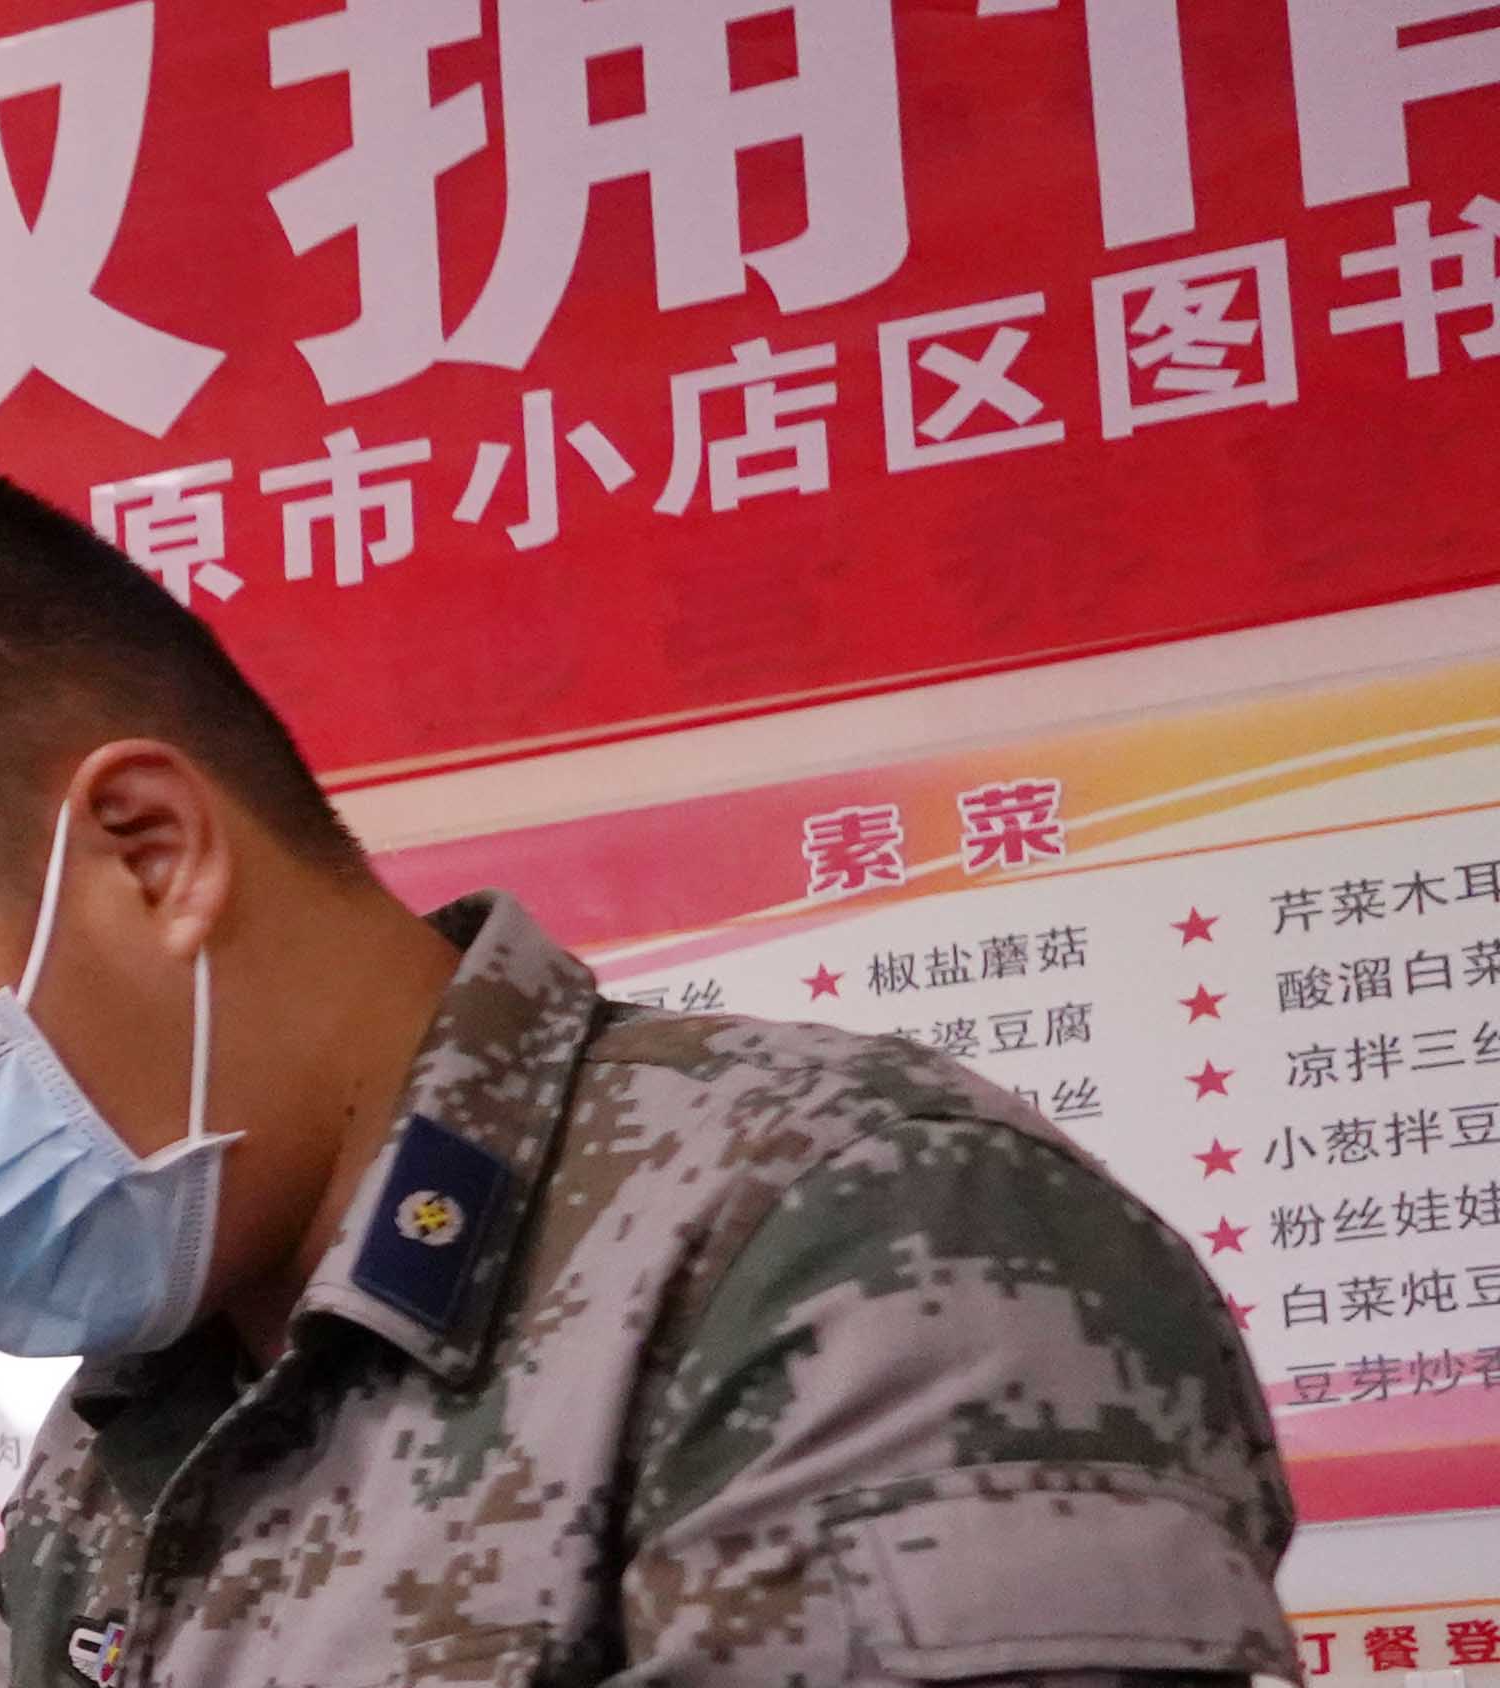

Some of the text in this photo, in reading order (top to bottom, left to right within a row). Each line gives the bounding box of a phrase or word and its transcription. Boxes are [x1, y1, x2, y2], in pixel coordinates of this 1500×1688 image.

[805, 780, 1062, 893] 素菜
[1269, 859, 1500, 934] 芹菜木耳
[867, 924, 1088, 997] 椒盐蘑菇
